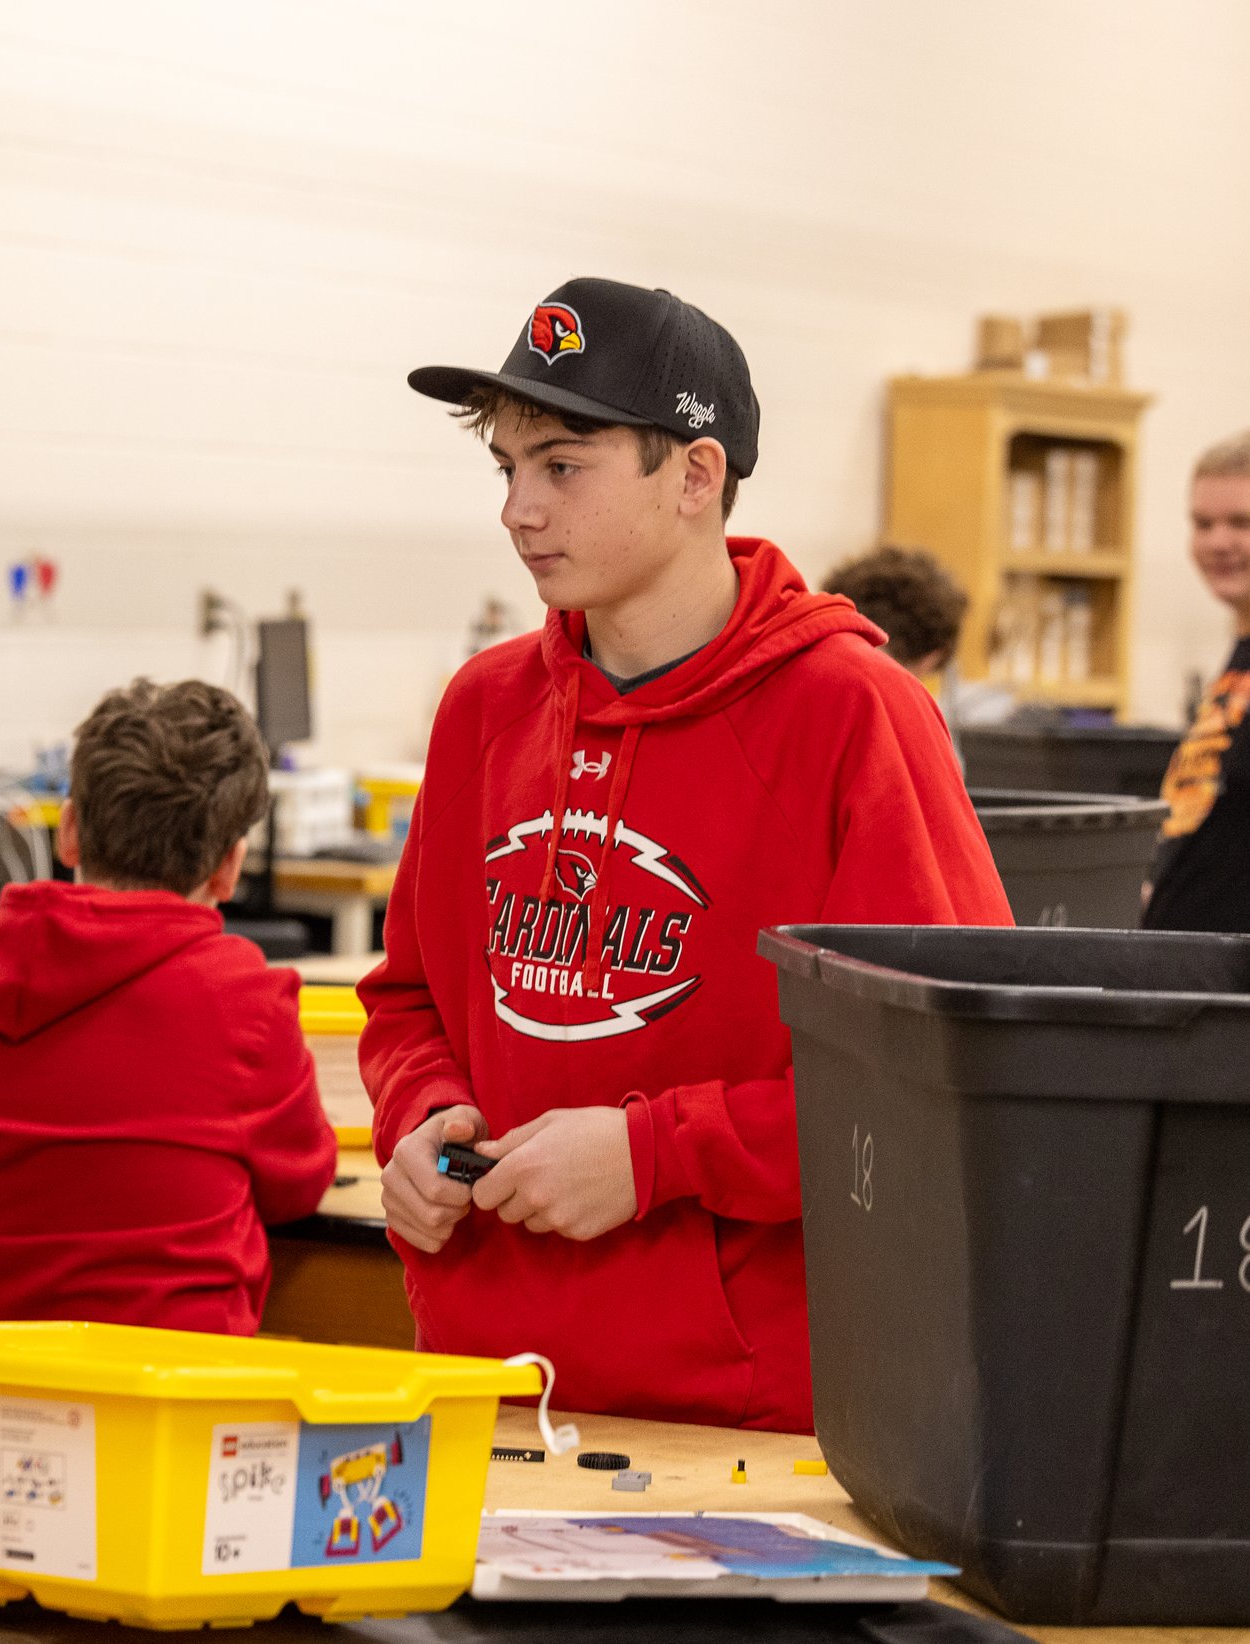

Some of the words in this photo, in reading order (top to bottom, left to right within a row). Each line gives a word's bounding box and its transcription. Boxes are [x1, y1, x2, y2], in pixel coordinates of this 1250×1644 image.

[675, 391, 716, 429] Waggle
[511, 961, 615, 1000] FOOTBAL
[850, 1123, 874, 1211] 18
[219, 1461, 286, 1503] spike
